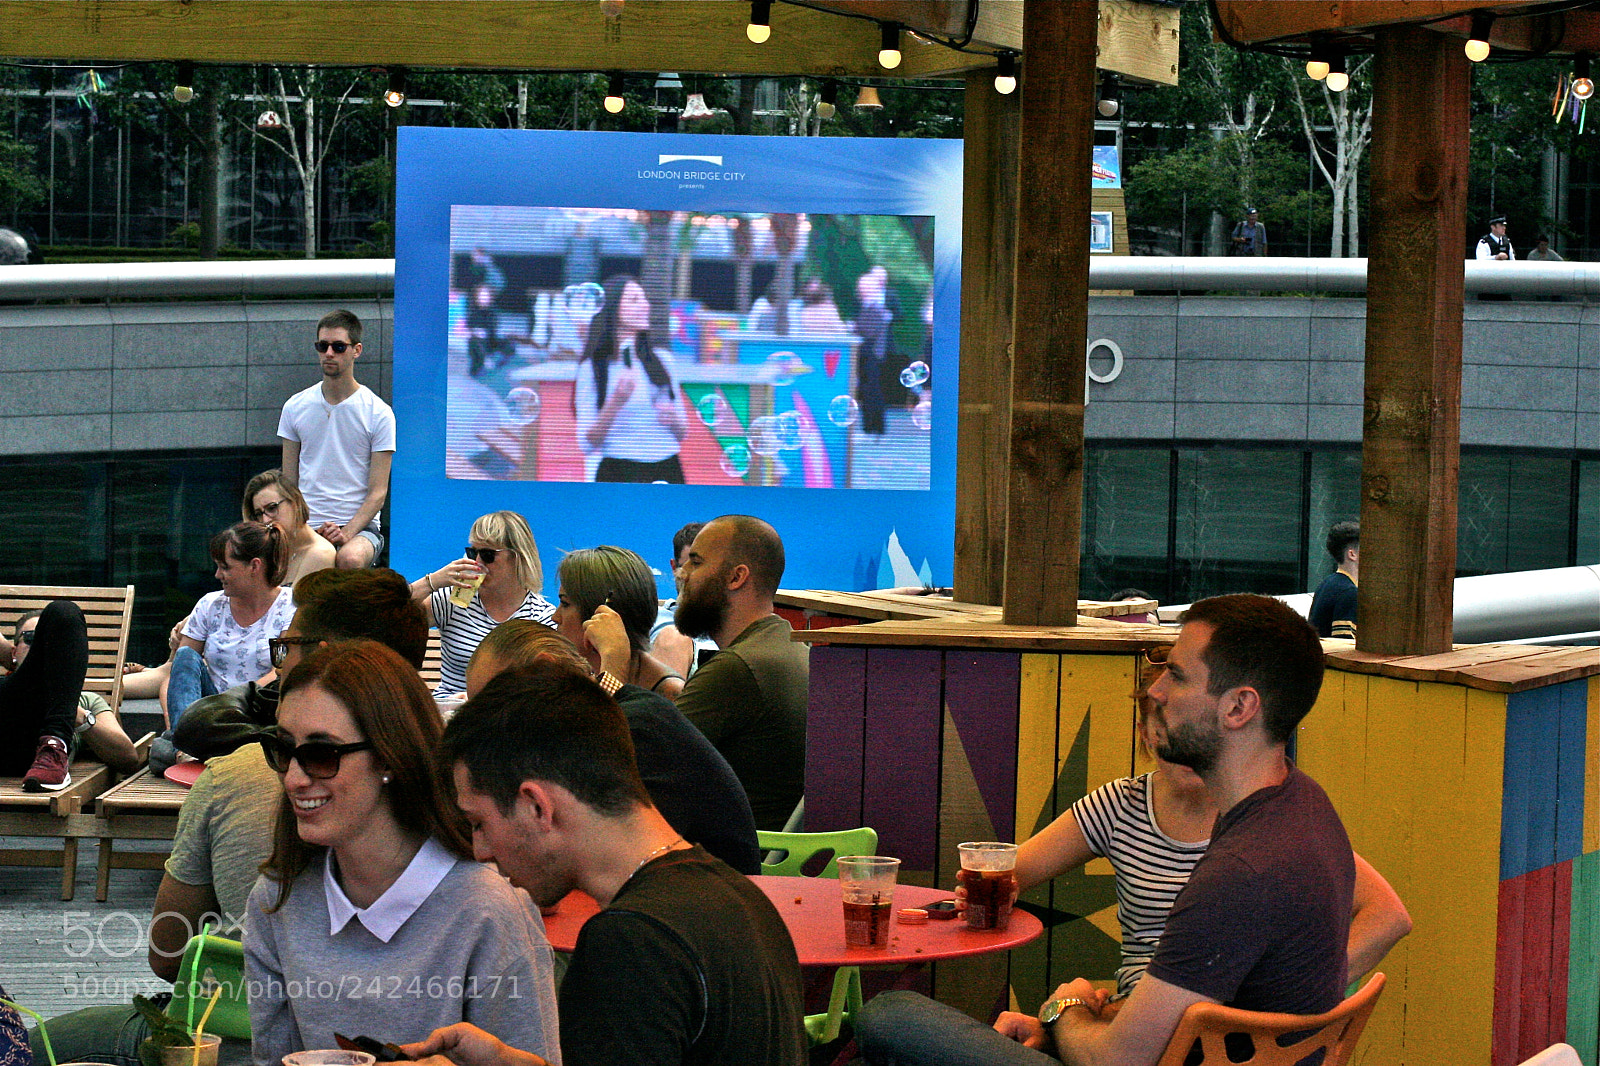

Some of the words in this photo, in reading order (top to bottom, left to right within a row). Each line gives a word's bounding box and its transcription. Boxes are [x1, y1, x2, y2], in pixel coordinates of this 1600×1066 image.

[637, 170, 681, 179] LONDON
[683, 171, 721, 181] BRIDGE
[723, 172, 746, 181] CITY
